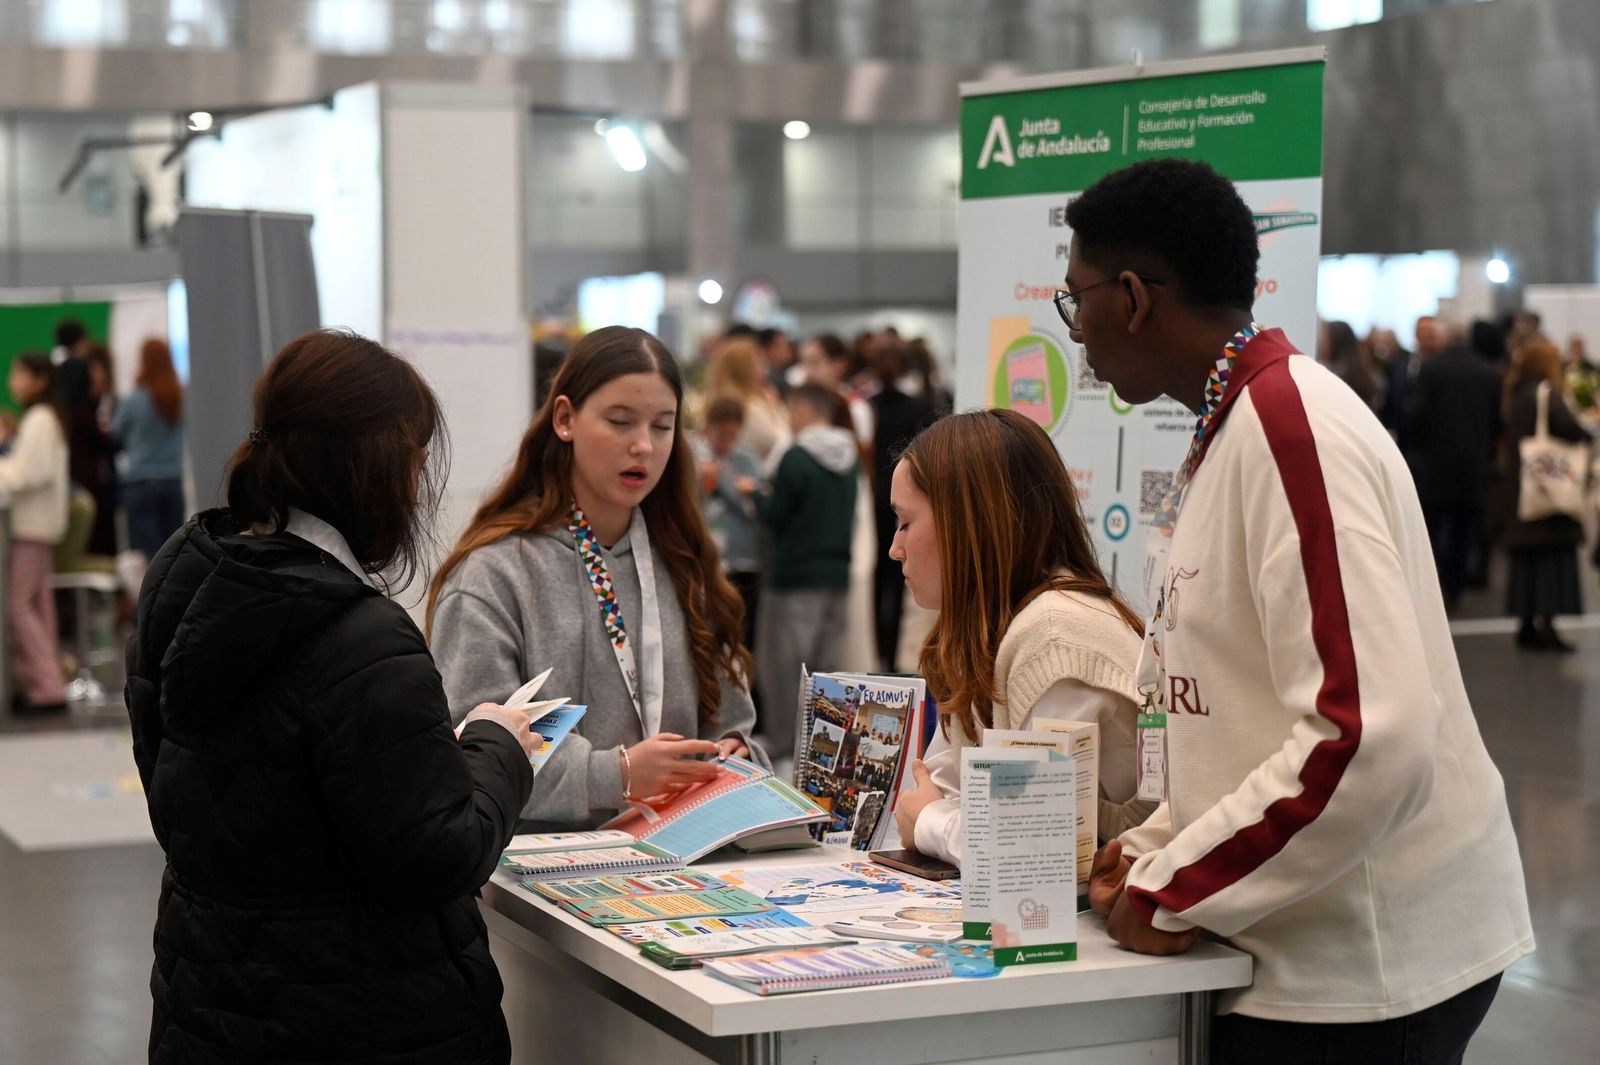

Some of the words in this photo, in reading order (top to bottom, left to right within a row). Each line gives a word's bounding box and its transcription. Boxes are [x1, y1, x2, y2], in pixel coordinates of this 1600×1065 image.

[1139, 98, 1193, 114] Consejería
[1194, 96, 1209, 109] de
[1210, 91, 1266, 108] Desarrollo
[1019, 117, 1061, 138] Junta
[1138, 118, 1188, 133] Educativo
[1189, 118, 1197, 132] y
[1198, 111, 1255, 128] Formación
[1017, 139, 1036, 159] de
[1037, 130, 1111, 156] Andalucía
[1137, 135, 1196, 152] Profesional
